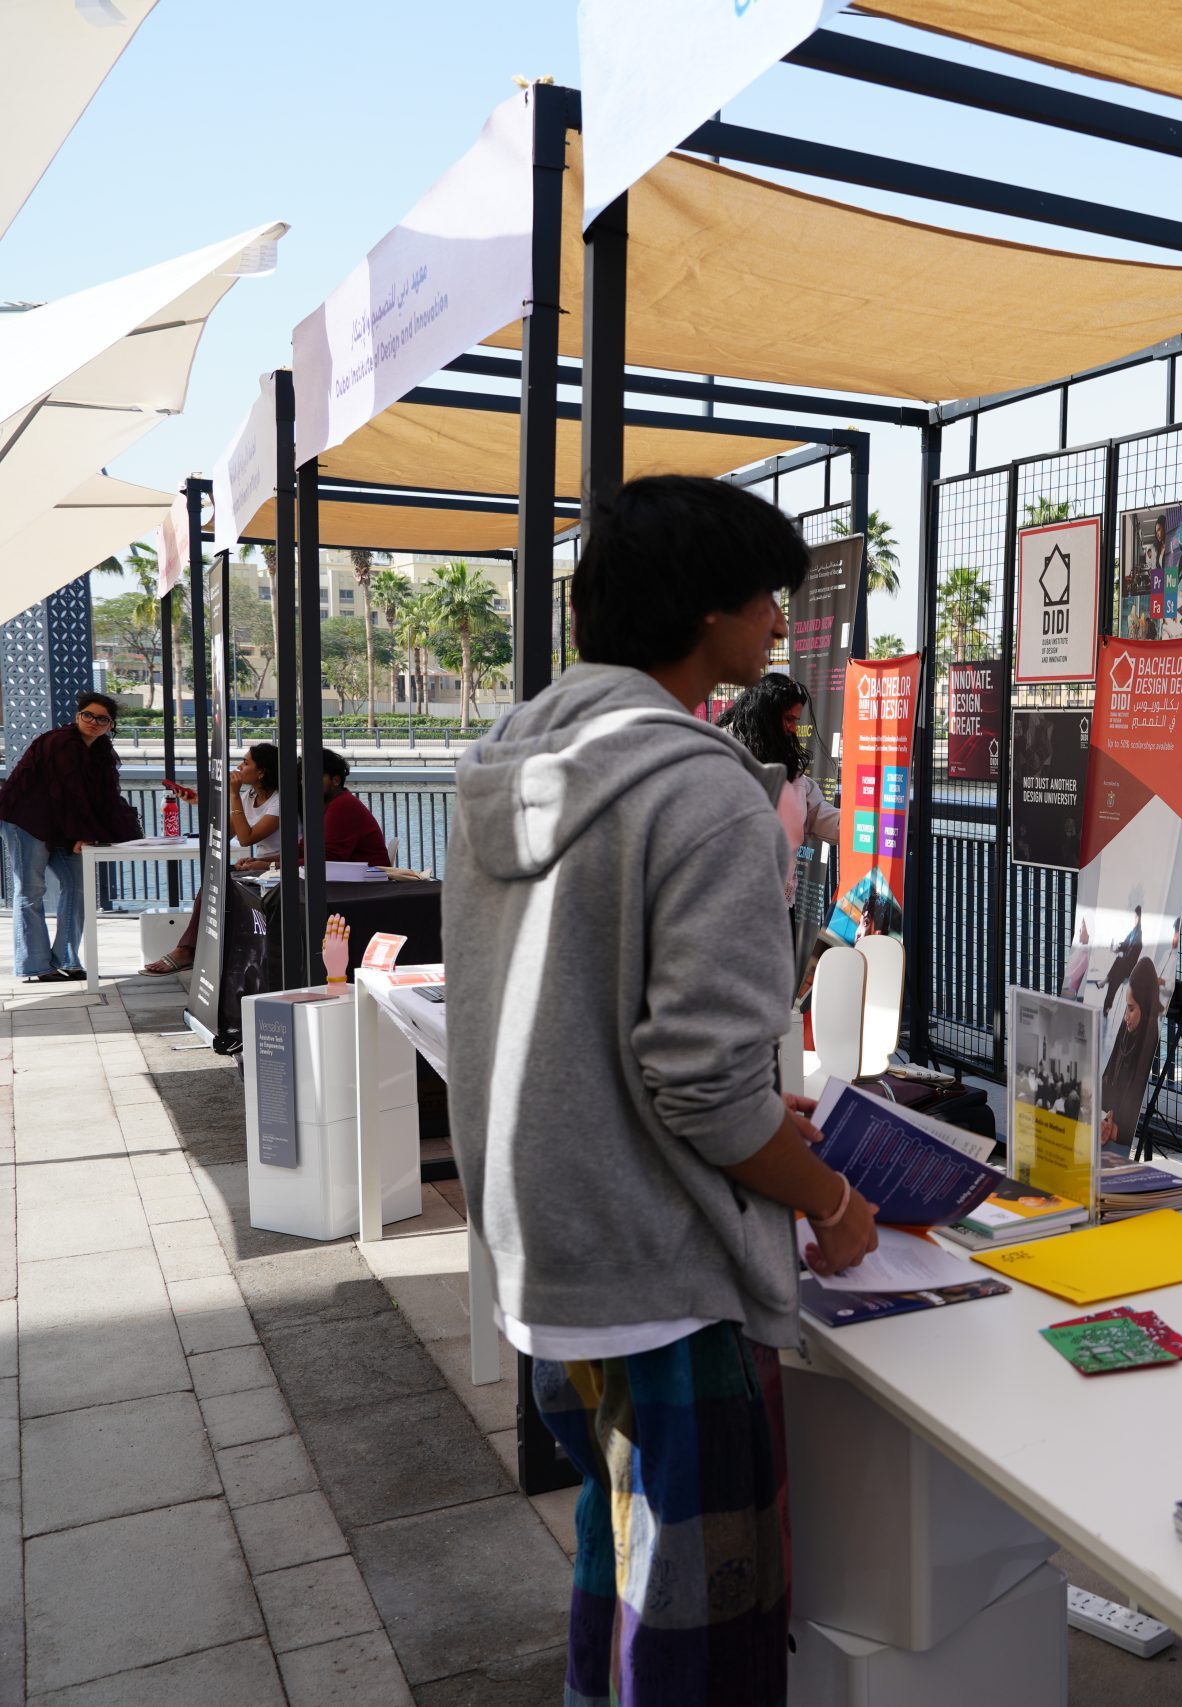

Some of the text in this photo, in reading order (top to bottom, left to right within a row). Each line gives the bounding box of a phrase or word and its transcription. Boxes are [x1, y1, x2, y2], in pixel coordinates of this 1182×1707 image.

[335, 292, 449, 398] Dubai Institute of Design and Innovation
[1153, 575, 1162, 589] Pr
[1153, 600, 1161, 614] Fa
[1166, 600, 1175, 613] St
[1042, 608, 1070, 635] DIDI
[870, 676, 911, 697] BACHELOR
[951, 670, 994, 690] INNOVATE.
[1135, 678, 1168, 695] DESIGN
[869, 699, 879, 720] IN
[881, 698, 909, 720] DESIGN
[951, 693, 983, 712] DESIGN.
[1110, 693, 1131, 710] DIDI
[951, 716, 983, 736] CREATE.
[1023, 776, 1077, 791] NOT JUST ANOTHER
[1023, 791, 1077, 805] DESIGN UNIVERSITY
